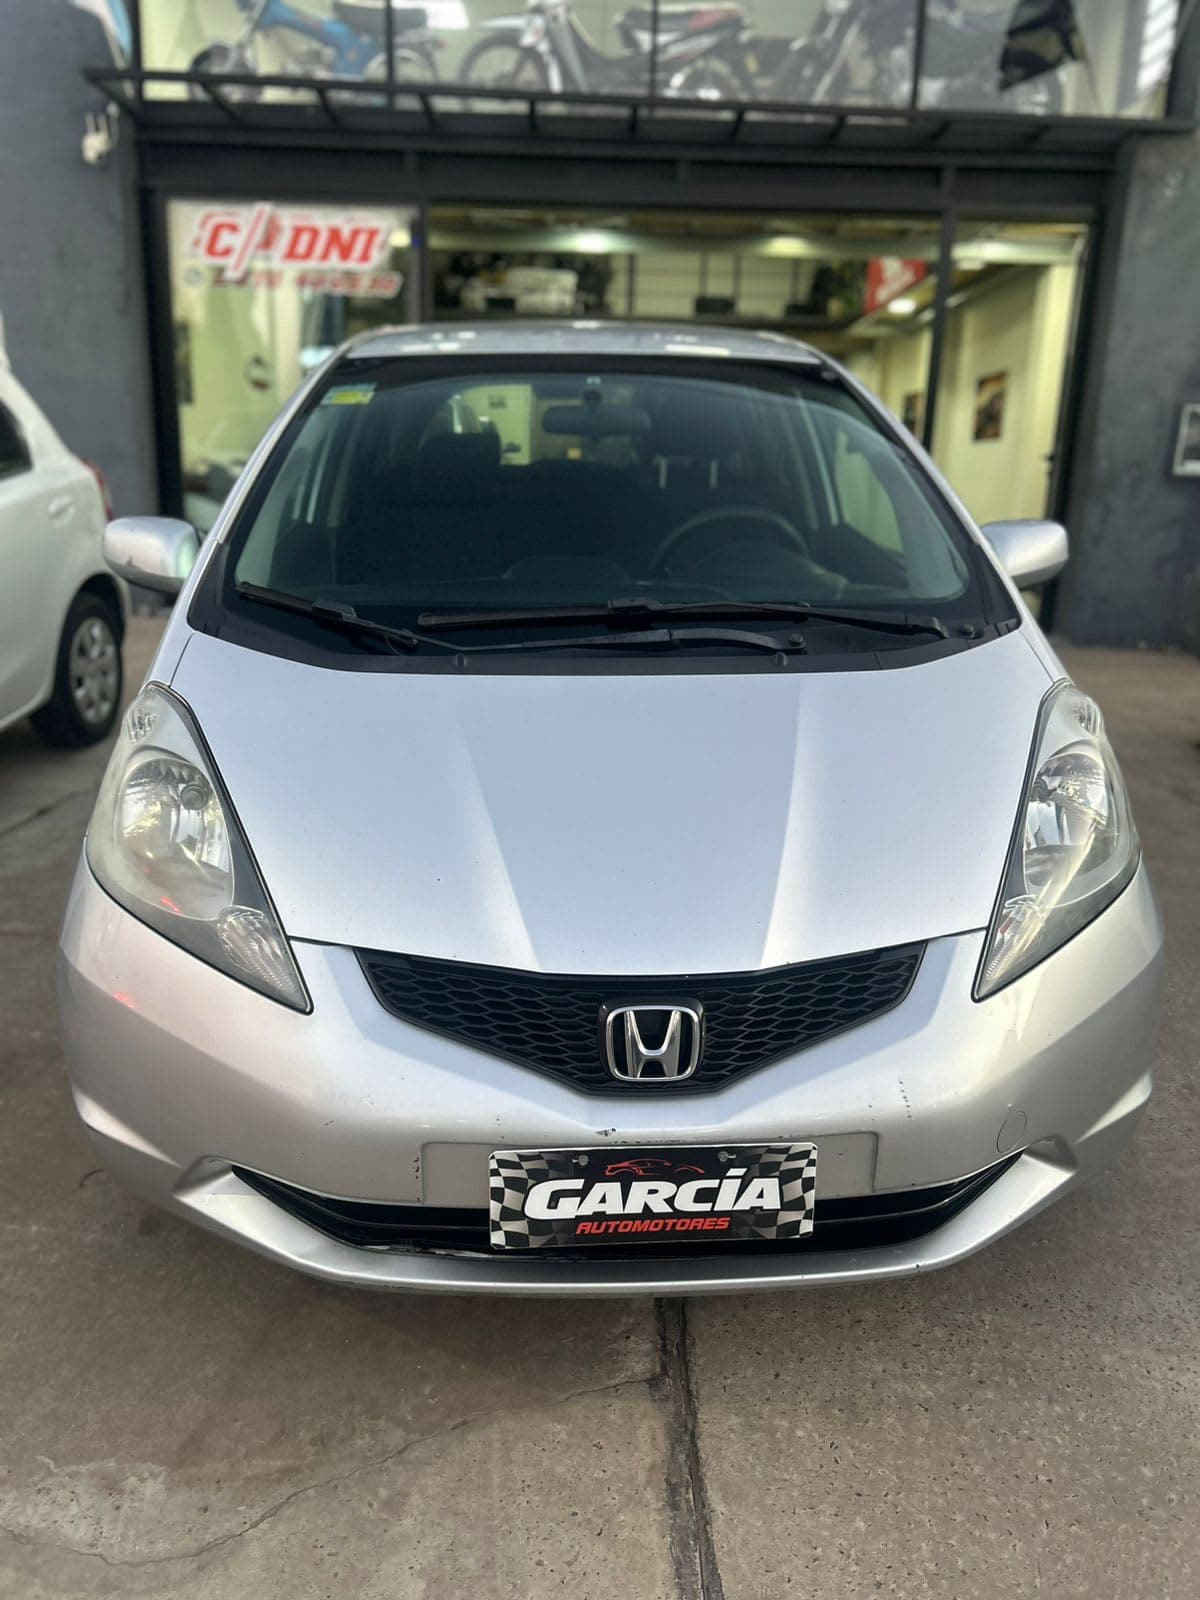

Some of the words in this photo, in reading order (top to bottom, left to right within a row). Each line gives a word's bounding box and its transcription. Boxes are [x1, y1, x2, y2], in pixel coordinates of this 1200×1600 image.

[282, 225, 380, 265] DNI
[523, 1168, 782, 1220] GARCÍA
[575, 1216, 732, 1236] AUTOMOTORES
